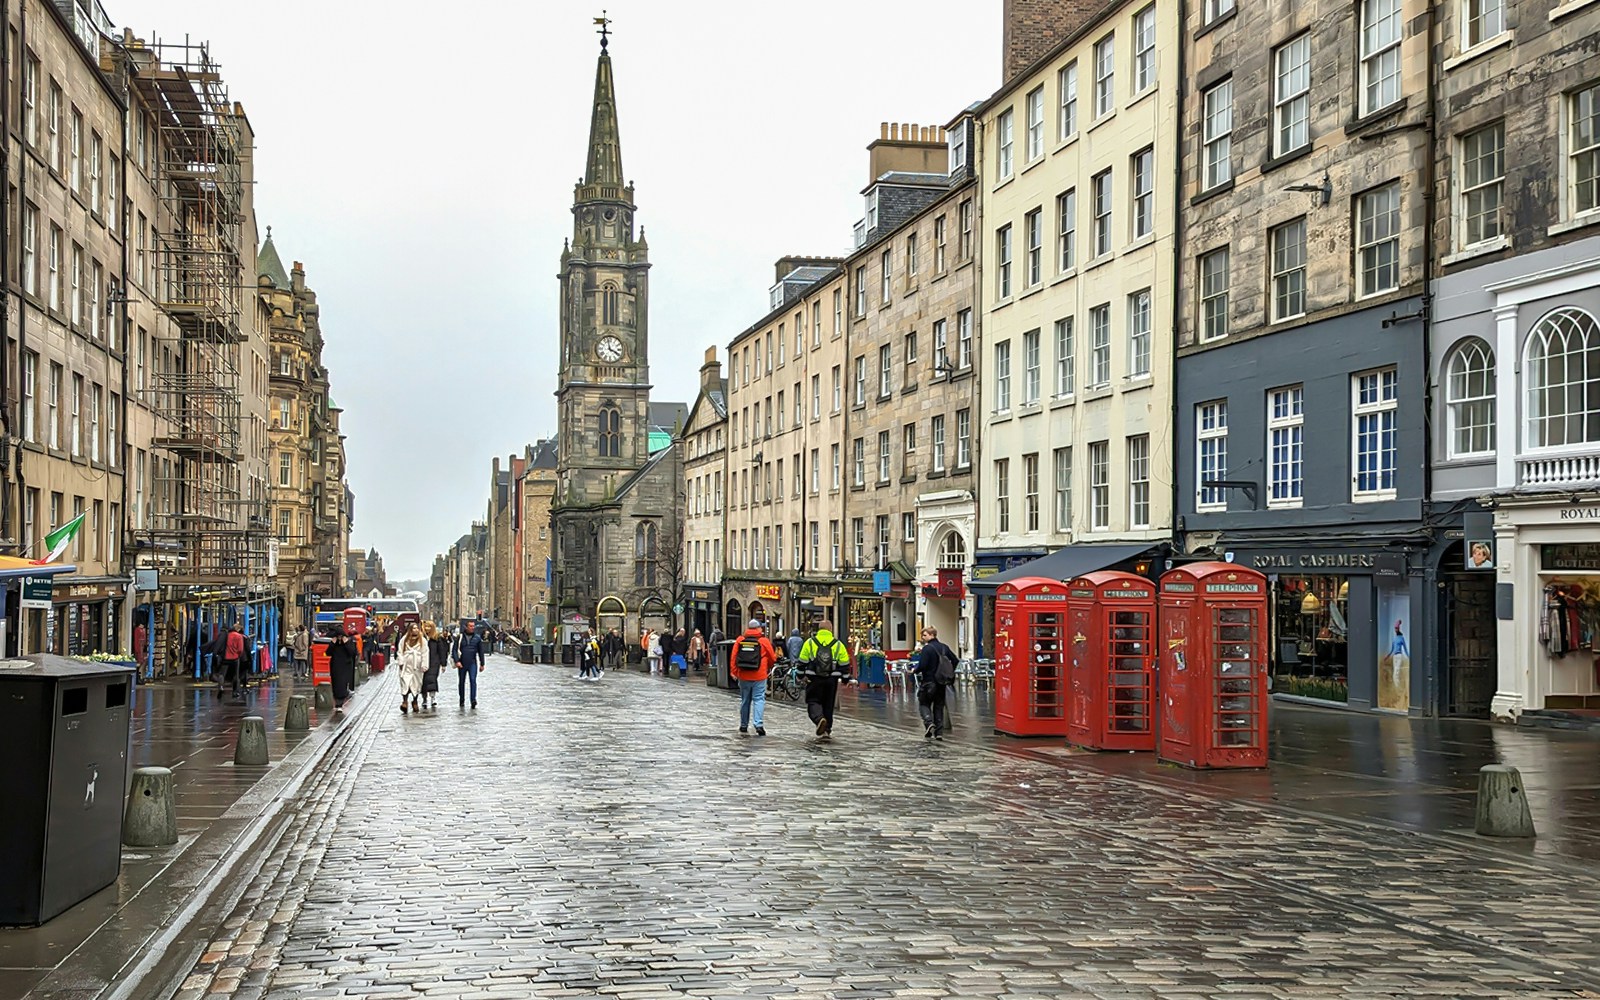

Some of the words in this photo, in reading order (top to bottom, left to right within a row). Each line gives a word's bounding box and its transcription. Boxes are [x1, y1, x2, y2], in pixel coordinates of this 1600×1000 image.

[1560, 508, 1600, 519] ROYAL
[1252, 554, 1293, 568] ROYAL
[1299, 553, 1377, 568] CASHMERE
[1556, 559, 1597, 568] OUTLET
[1207, 583, 1256, 592] TELEPHONE
